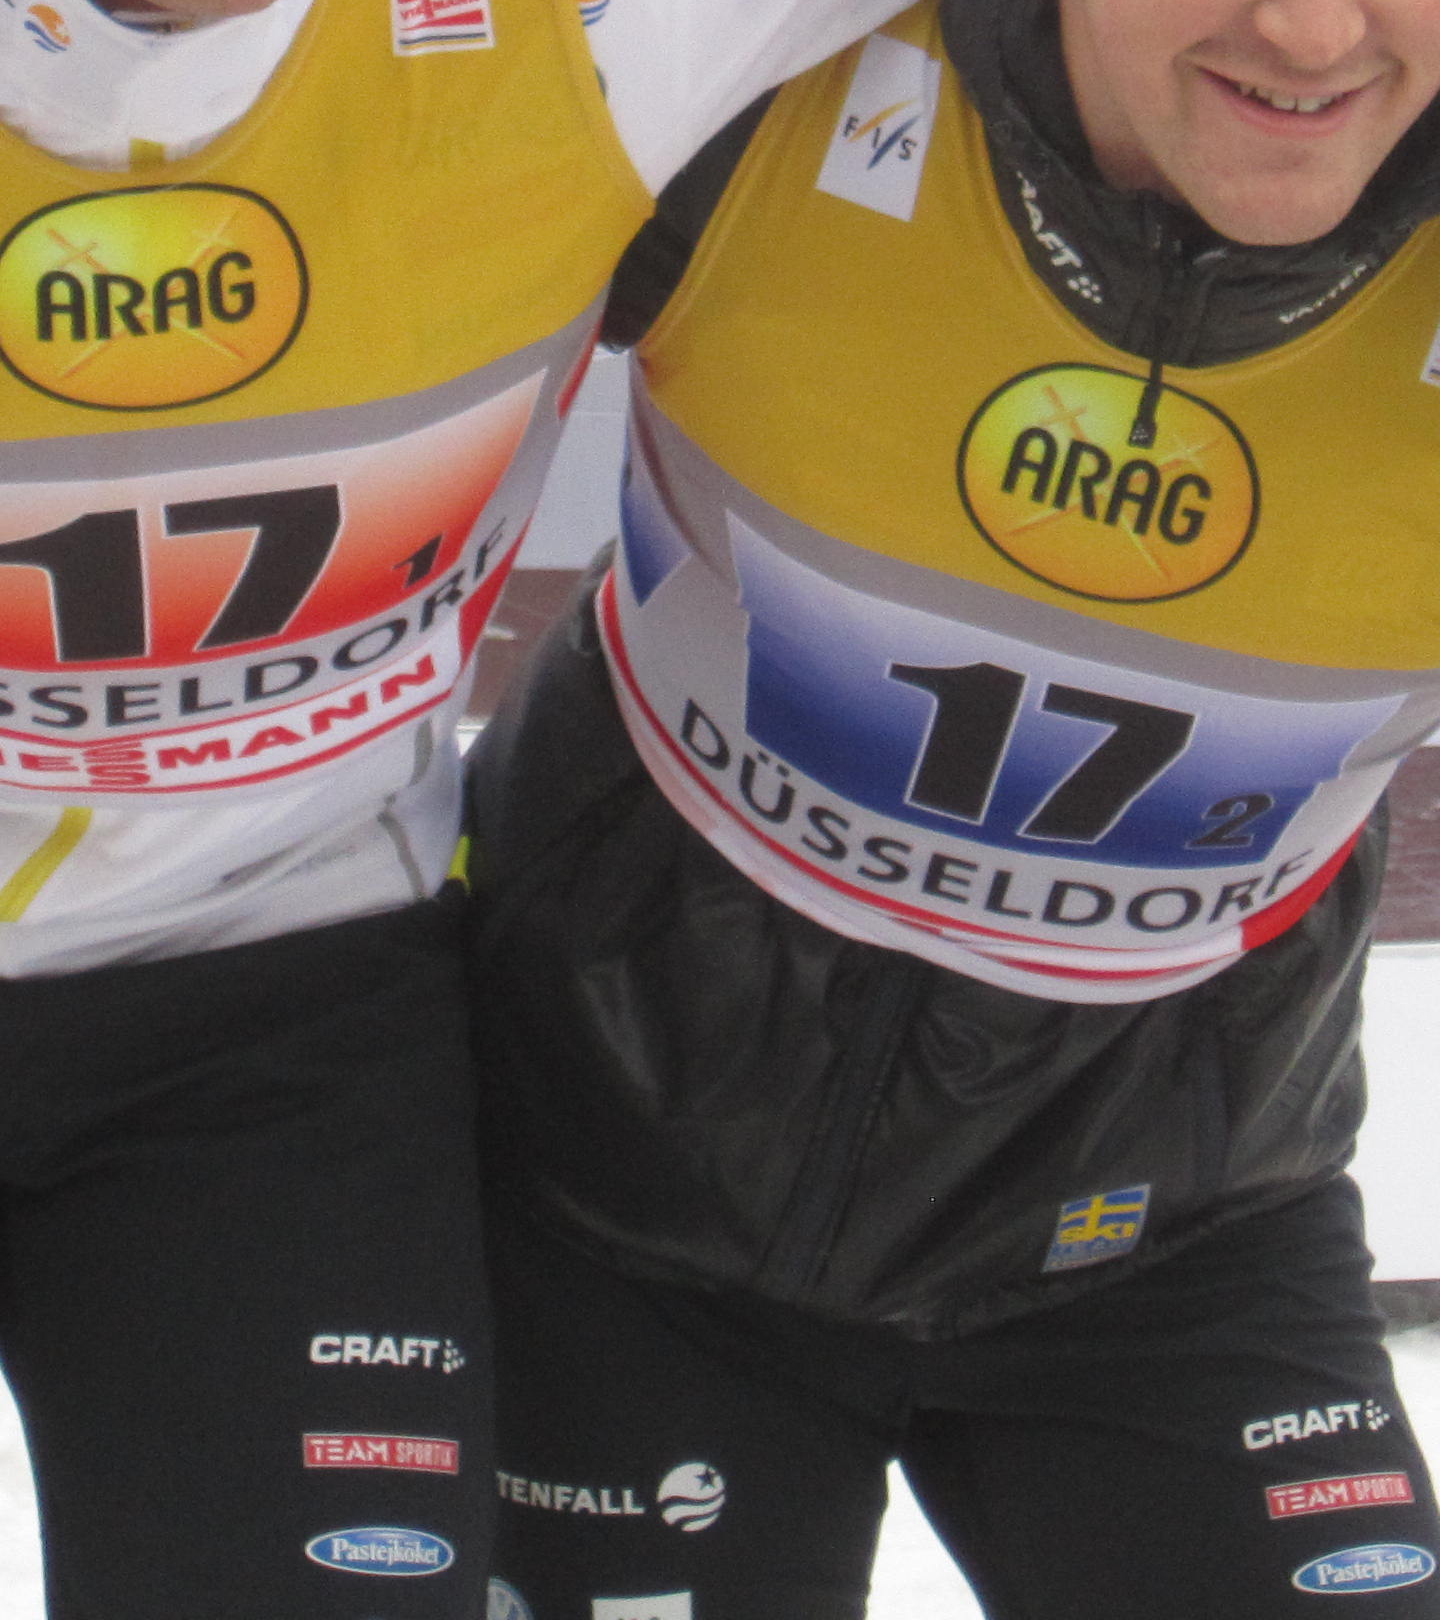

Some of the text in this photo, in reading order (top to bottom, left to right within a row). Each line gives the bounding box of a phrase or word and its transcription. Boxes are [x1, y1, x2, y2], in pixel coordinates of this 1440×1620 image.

[842, 115, 918, 162] FIS
[35, 251, 257, 342] ARAG
[1000, 427, 1213, 546] ARAG
[393, 533, 444, 590] 1
[883, 660, 1276, 851] 17 2
[679, 698, 1315, 934] DÜSSELDORF
[309, 1333, 440, 1368] CRAFT
[310, 1437, 389, 1464] TEAM
[1242, 1403, 1363, 1452] CRAFT
[1273, 1481, 1350, 1511] TEAM
